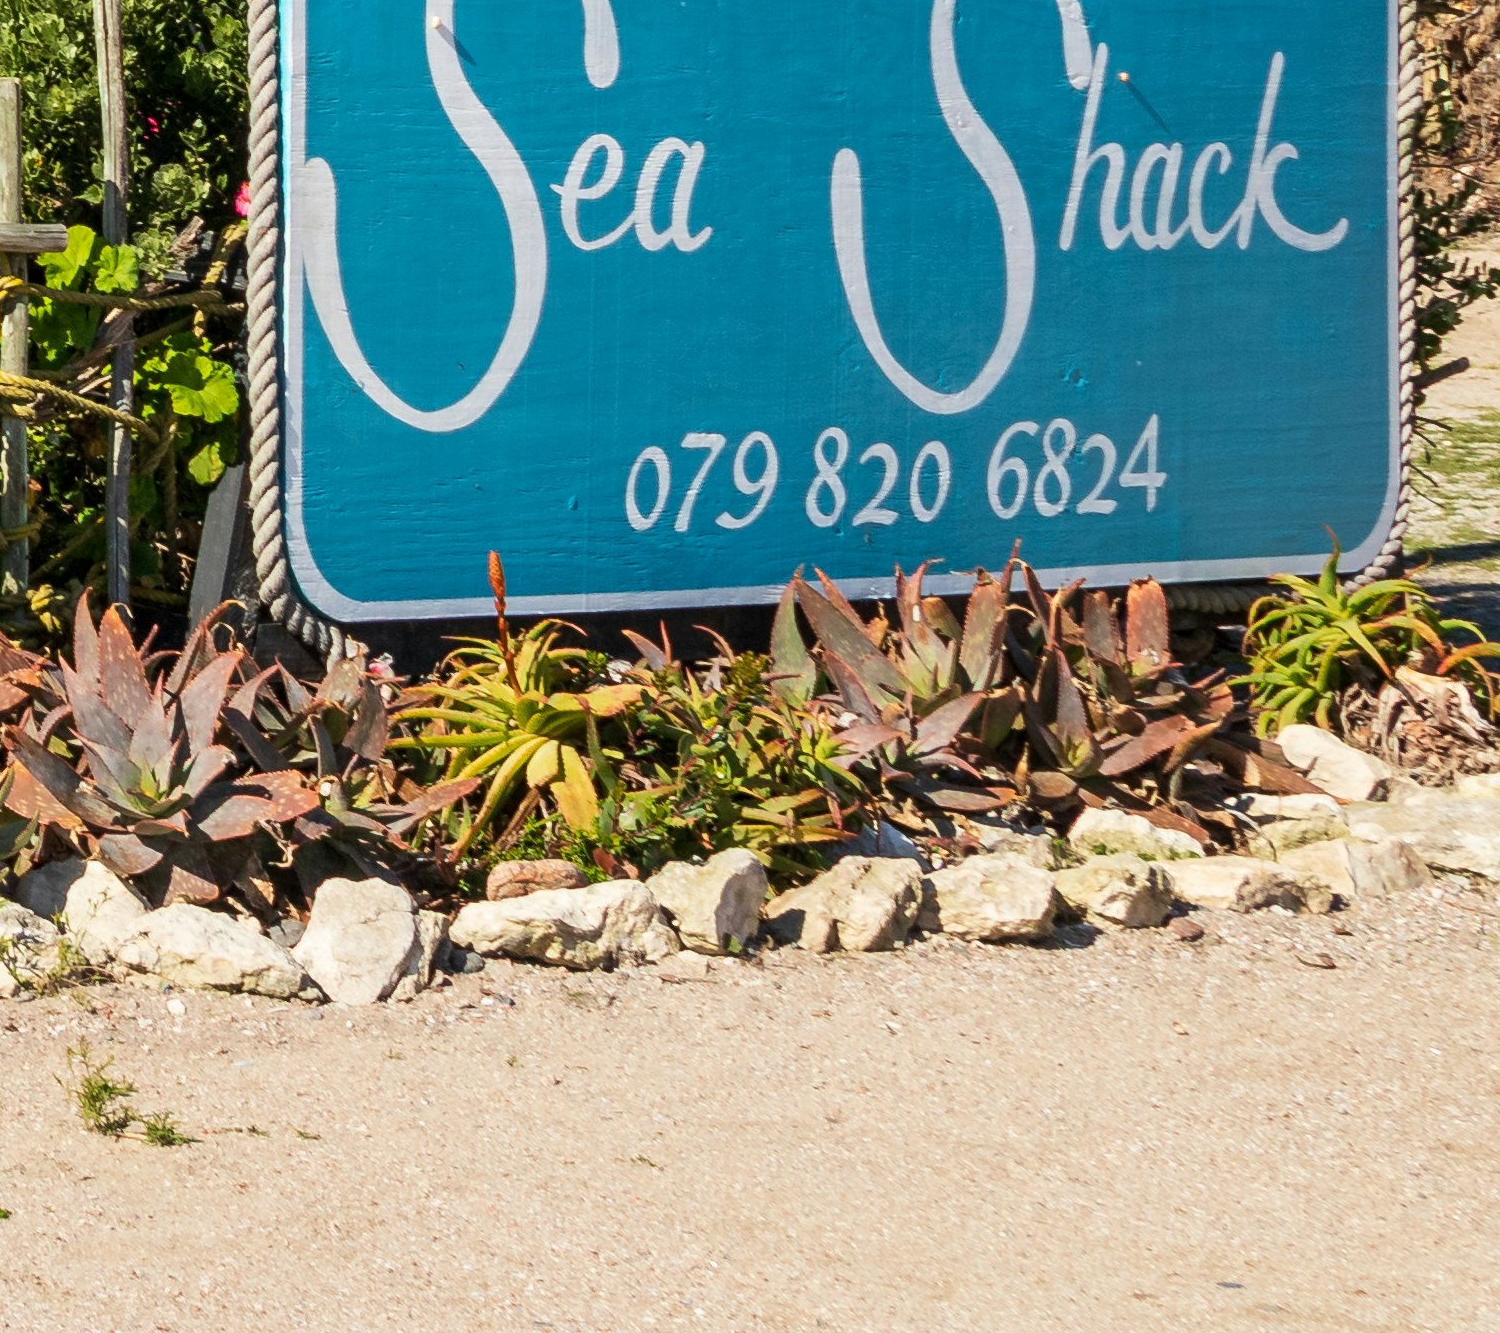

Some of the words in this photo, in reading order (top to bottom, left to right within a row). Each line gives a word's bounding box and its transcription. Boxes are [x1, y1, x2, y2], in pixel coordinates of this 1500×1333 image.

[625, 430, 779, 533] 079
[805, 424, 954, 526] 820
[986, 412, 1168, 520] 6824
